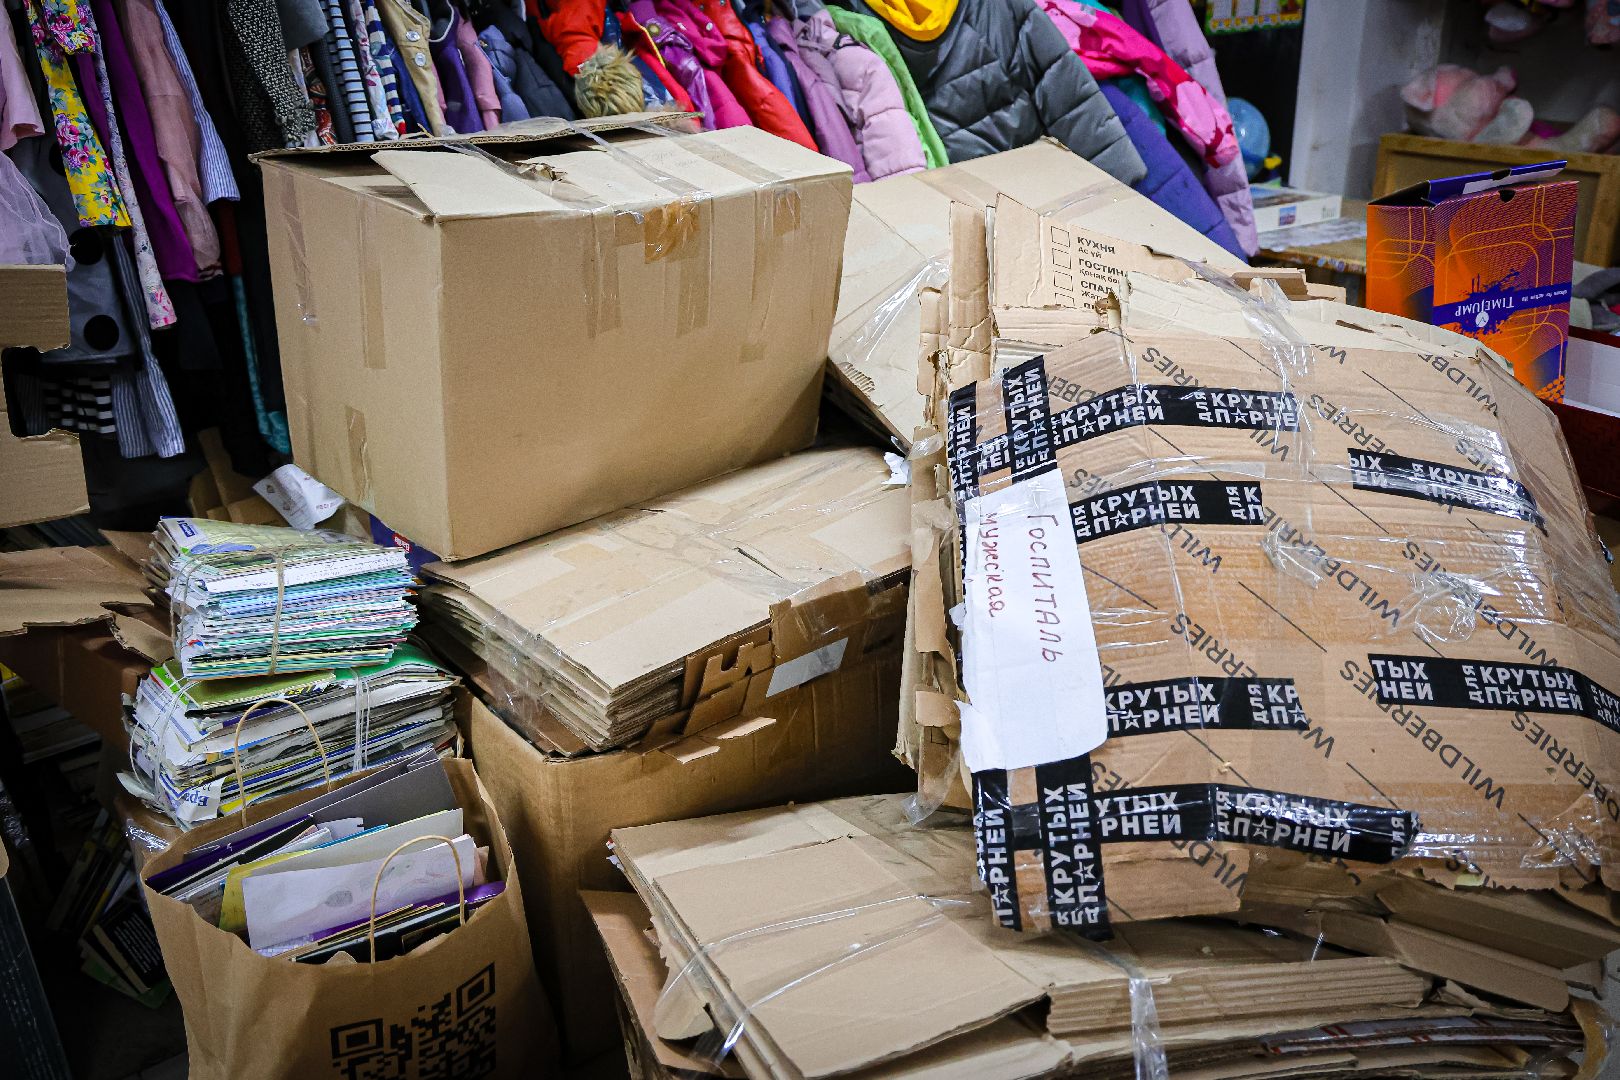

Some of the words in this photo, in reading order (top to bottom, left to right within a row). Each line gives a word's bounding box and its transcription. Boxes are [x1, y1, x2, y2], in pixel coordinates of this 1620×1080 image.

[1077, 237, 1115, 254] КУХНЯ
[1078, 258, 1126, 278] ГОСТИН
[1080, 280, 1114, 294] СПАЛ
[1081, 290, 1102, 301] Жат
[1007, 374, 1031, 455] КРУТЫХ
[1061, 389, 1161, 426] КРУТЫХ
[1211, 392, 1299, 413] КРУТЫ
[1091, 485, 1196, 517] КРУТЫХ
[1226, 486, 1247, 520] ДЛЯ
[1073, 504, 1092, 538] ДЛЯ
[1371, 659, 1428, 681] ТЫХ
[1479, 666, 1578, 691] КРУТЫХ
[1104, 683, 1216, 710] КРУТЫХ
[1461, 664, 1485, 704] ДЛЯ
[1247, 684, 1270, 724] ДЛЯ
[1095, 791, 1178, 817] УТЫХ
[1102, 813, 1182, 837] РНЕЙ
[1044, 785, 1076, 905] КРУТЫХ
[1056, 906, 1099, 925] ДЛЯ
